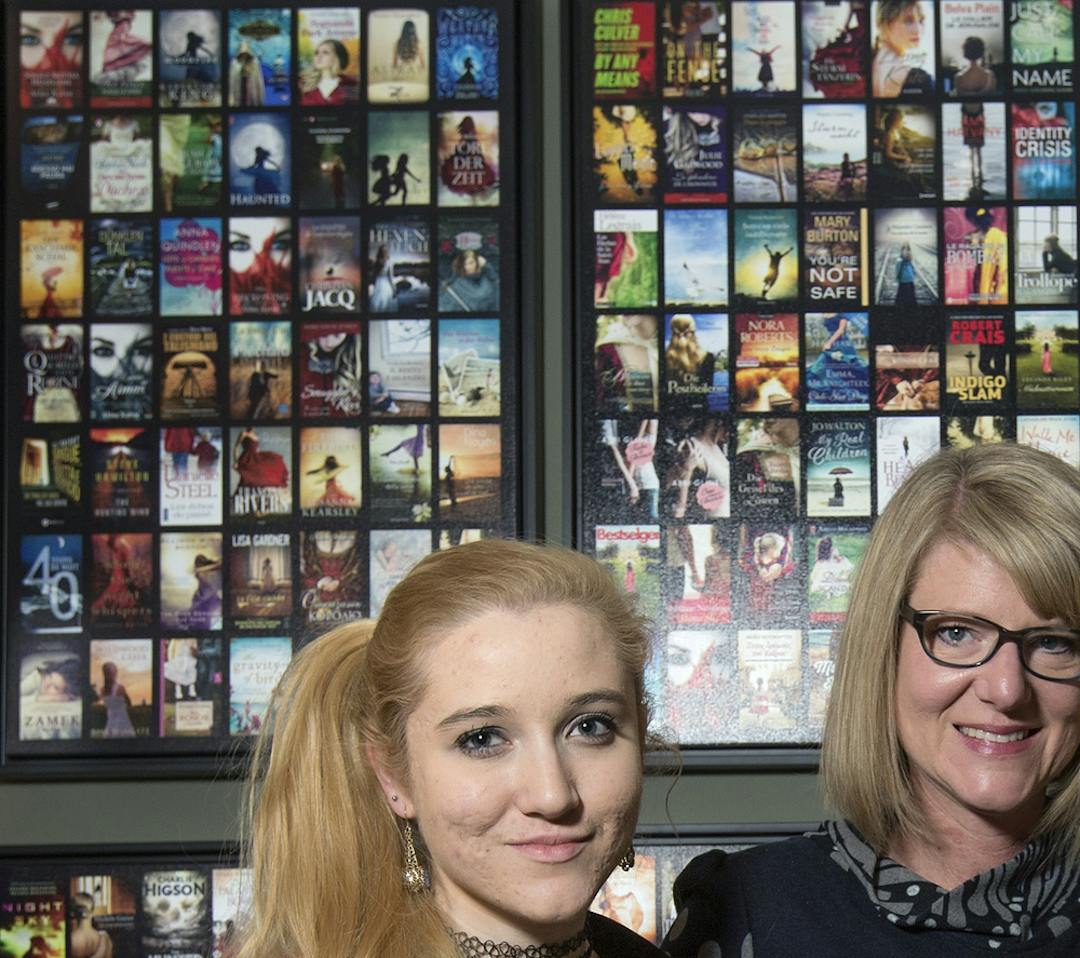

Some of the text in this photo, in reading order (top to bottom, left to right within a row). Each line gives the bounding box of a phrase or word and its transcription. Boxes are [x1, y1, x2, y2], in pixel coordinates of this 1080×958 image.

[594, 8, 633, 24] CHRIS
[594, 53, 639, 70] BY ANY
[594, 71, 640, 88] MEANS
[1012, 69, 1073, 86] NAME
[1015, 127, 1072, 140] IDENTITY
[1015, 140, 1072, 158] CRISIS
[453, 156, 485, 170] DER
[451, 171, 486, 185] ZEIT
[230, 193, 291, 206] HAUNTED
[814, 216, 851, 227] MARY
[174, 228, 208, 237] ANNA
[806, 229, 858, 242] BURTON
[809, 268, 858, 283] NOT
[1016, 273, 1077, 292] Trollope
[810, 286, 857, 299] SAFE
[302, 289, 356, 311] JACQ
[748, 320, 784, 331] NORA
[951, 320, 1003, 331] ROBERT
[740, 331, 793, 343] ROBERTS
[950, 331, 1005, 344] CRAIS
[950, 376, 1006, 388] INDIGO
[959, 389, 1001, 401] SLAM
[165, 482, 217, 498] STEEL
[235, 494, 289, 514] RIVERS
[302, 508, 358, 517] KEARSLEY
[232, 533, 291, 546] LISA GARDNER
[25, 716, 79, 727] ZAMEK
[143, 883, 205, 896] HIGSON
